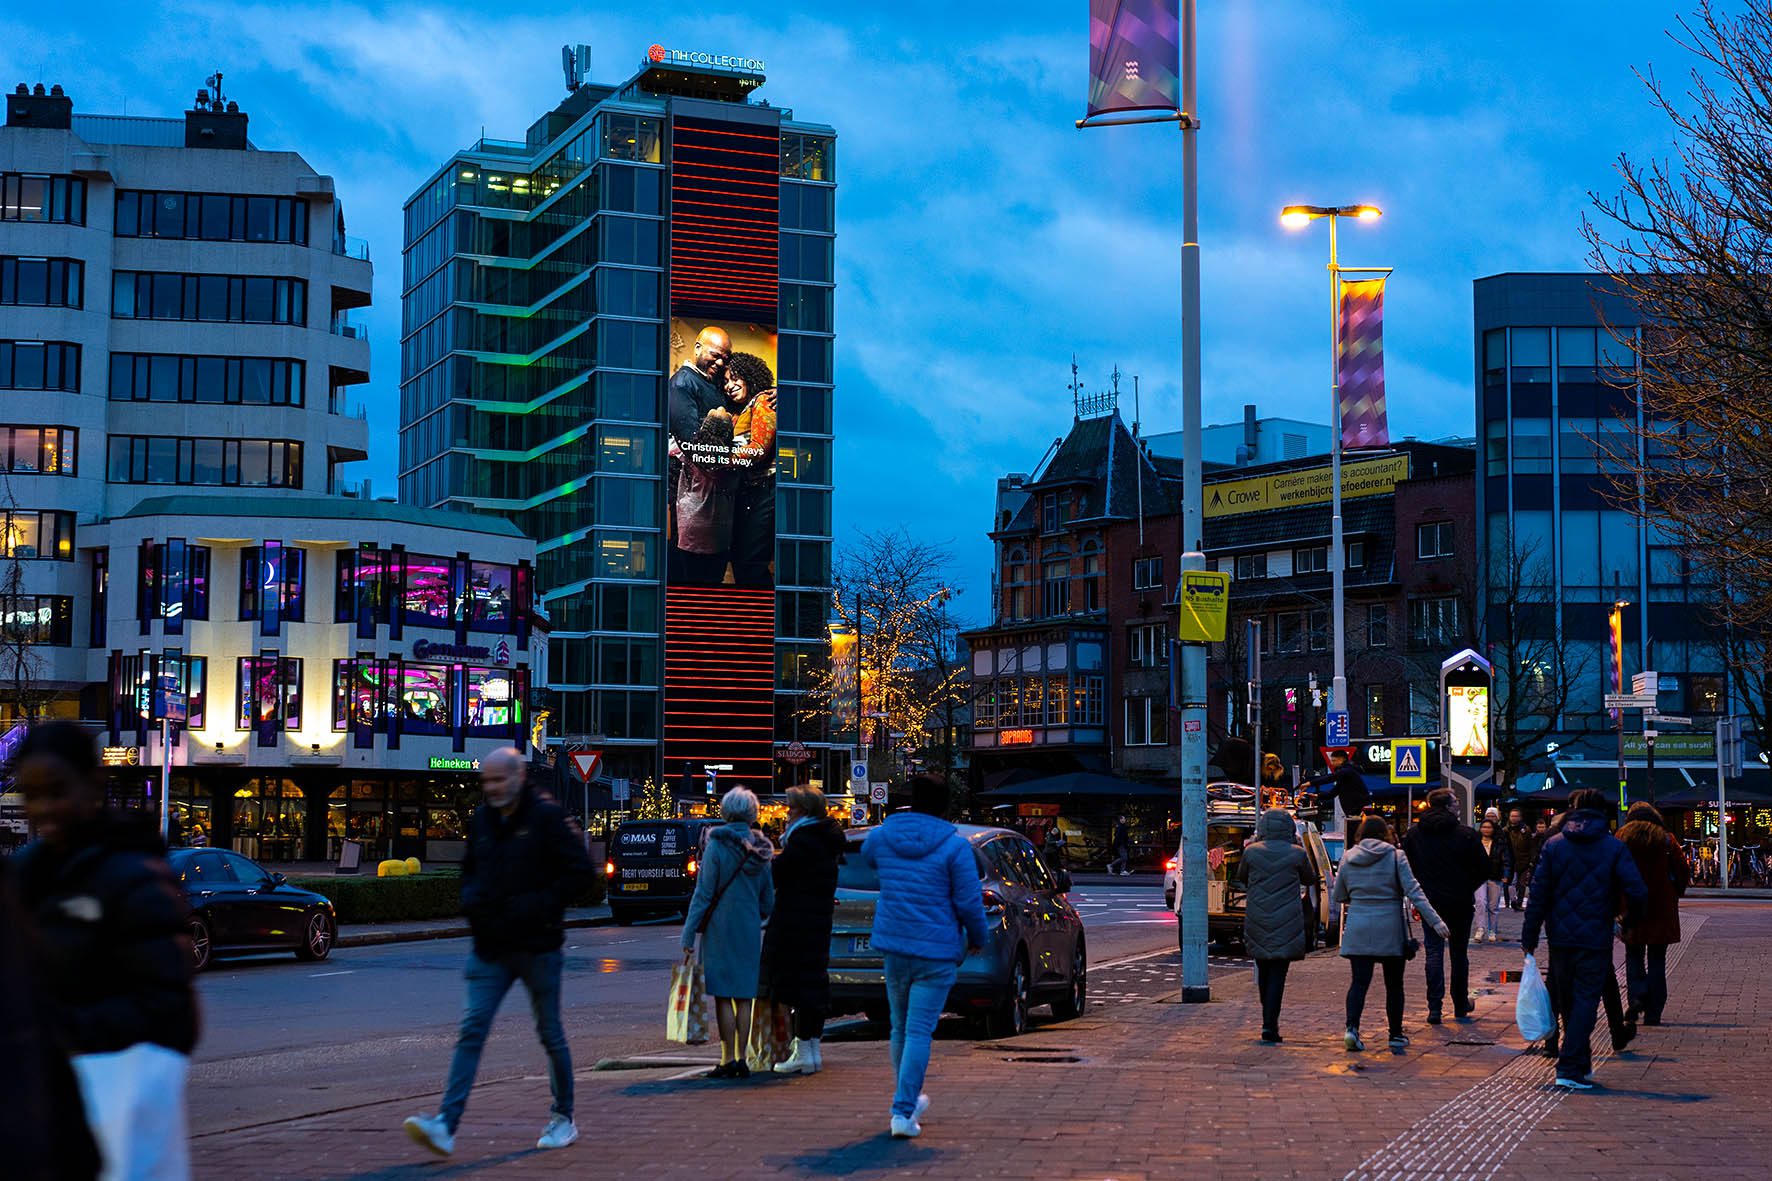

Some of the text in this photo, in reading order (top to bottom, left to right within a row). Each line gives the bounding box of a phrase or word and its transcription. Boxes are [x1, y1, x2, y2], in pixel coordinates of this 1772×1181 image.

[690, 51, 765, 70] COLLECTION
[681, 442, 765, 457] Christmas always
[692, 454, 754, 467] finds its way.
[1350, 460, 1403, 477] accountant?
[1280, 475, 1395, 500] werkenbijcroefoederer.nl
[1228, 490, 1260, 505] Crowe
[1637, 742, 1648, 750] yo
[430, 757, 470, 769] Heineken
[631, 834, 656, 842] MAAS
[622, 868, 680, 878] TREAT YOURSELF WELL
